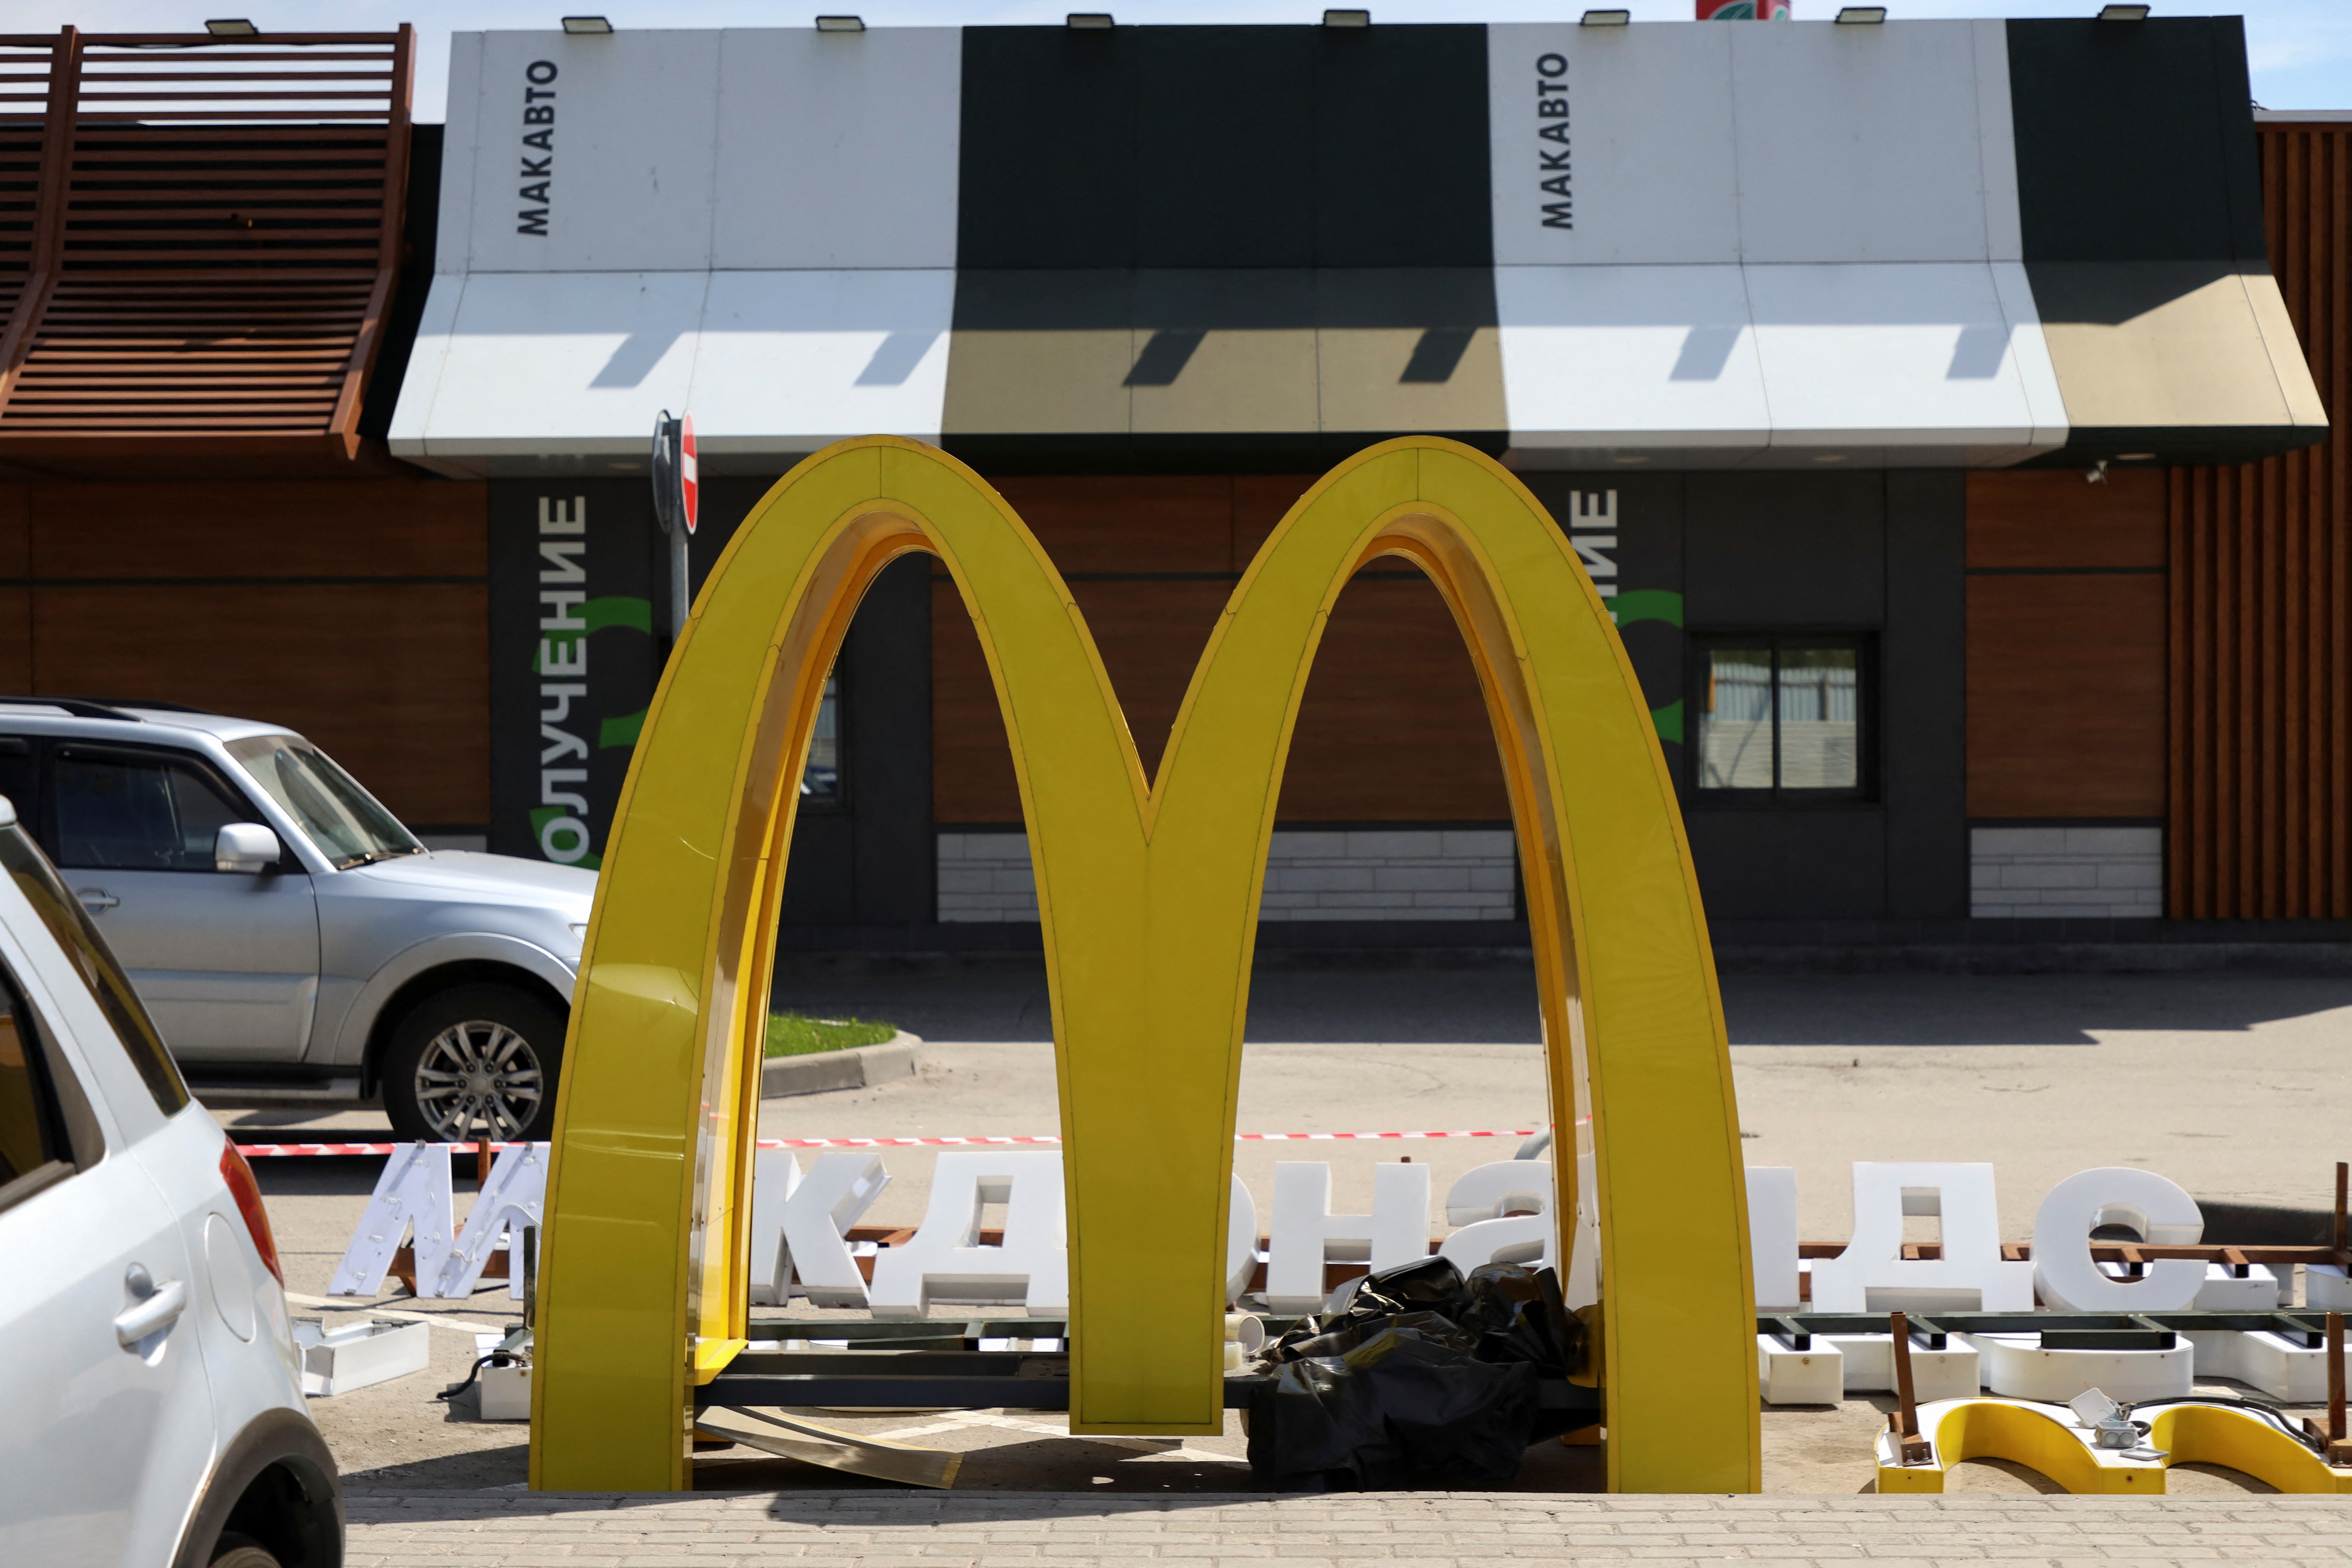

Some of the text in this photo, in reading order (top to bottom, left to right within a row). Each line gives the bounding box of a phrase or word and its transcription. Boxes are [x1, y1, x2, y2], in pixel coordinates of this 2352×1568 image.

[517, 60, 558, 236] МАКАВТО
[1536, 53, 1572, 229] МАКАВТО
[538, 495, 590, 864] ОЛУЧЕНИЕ
